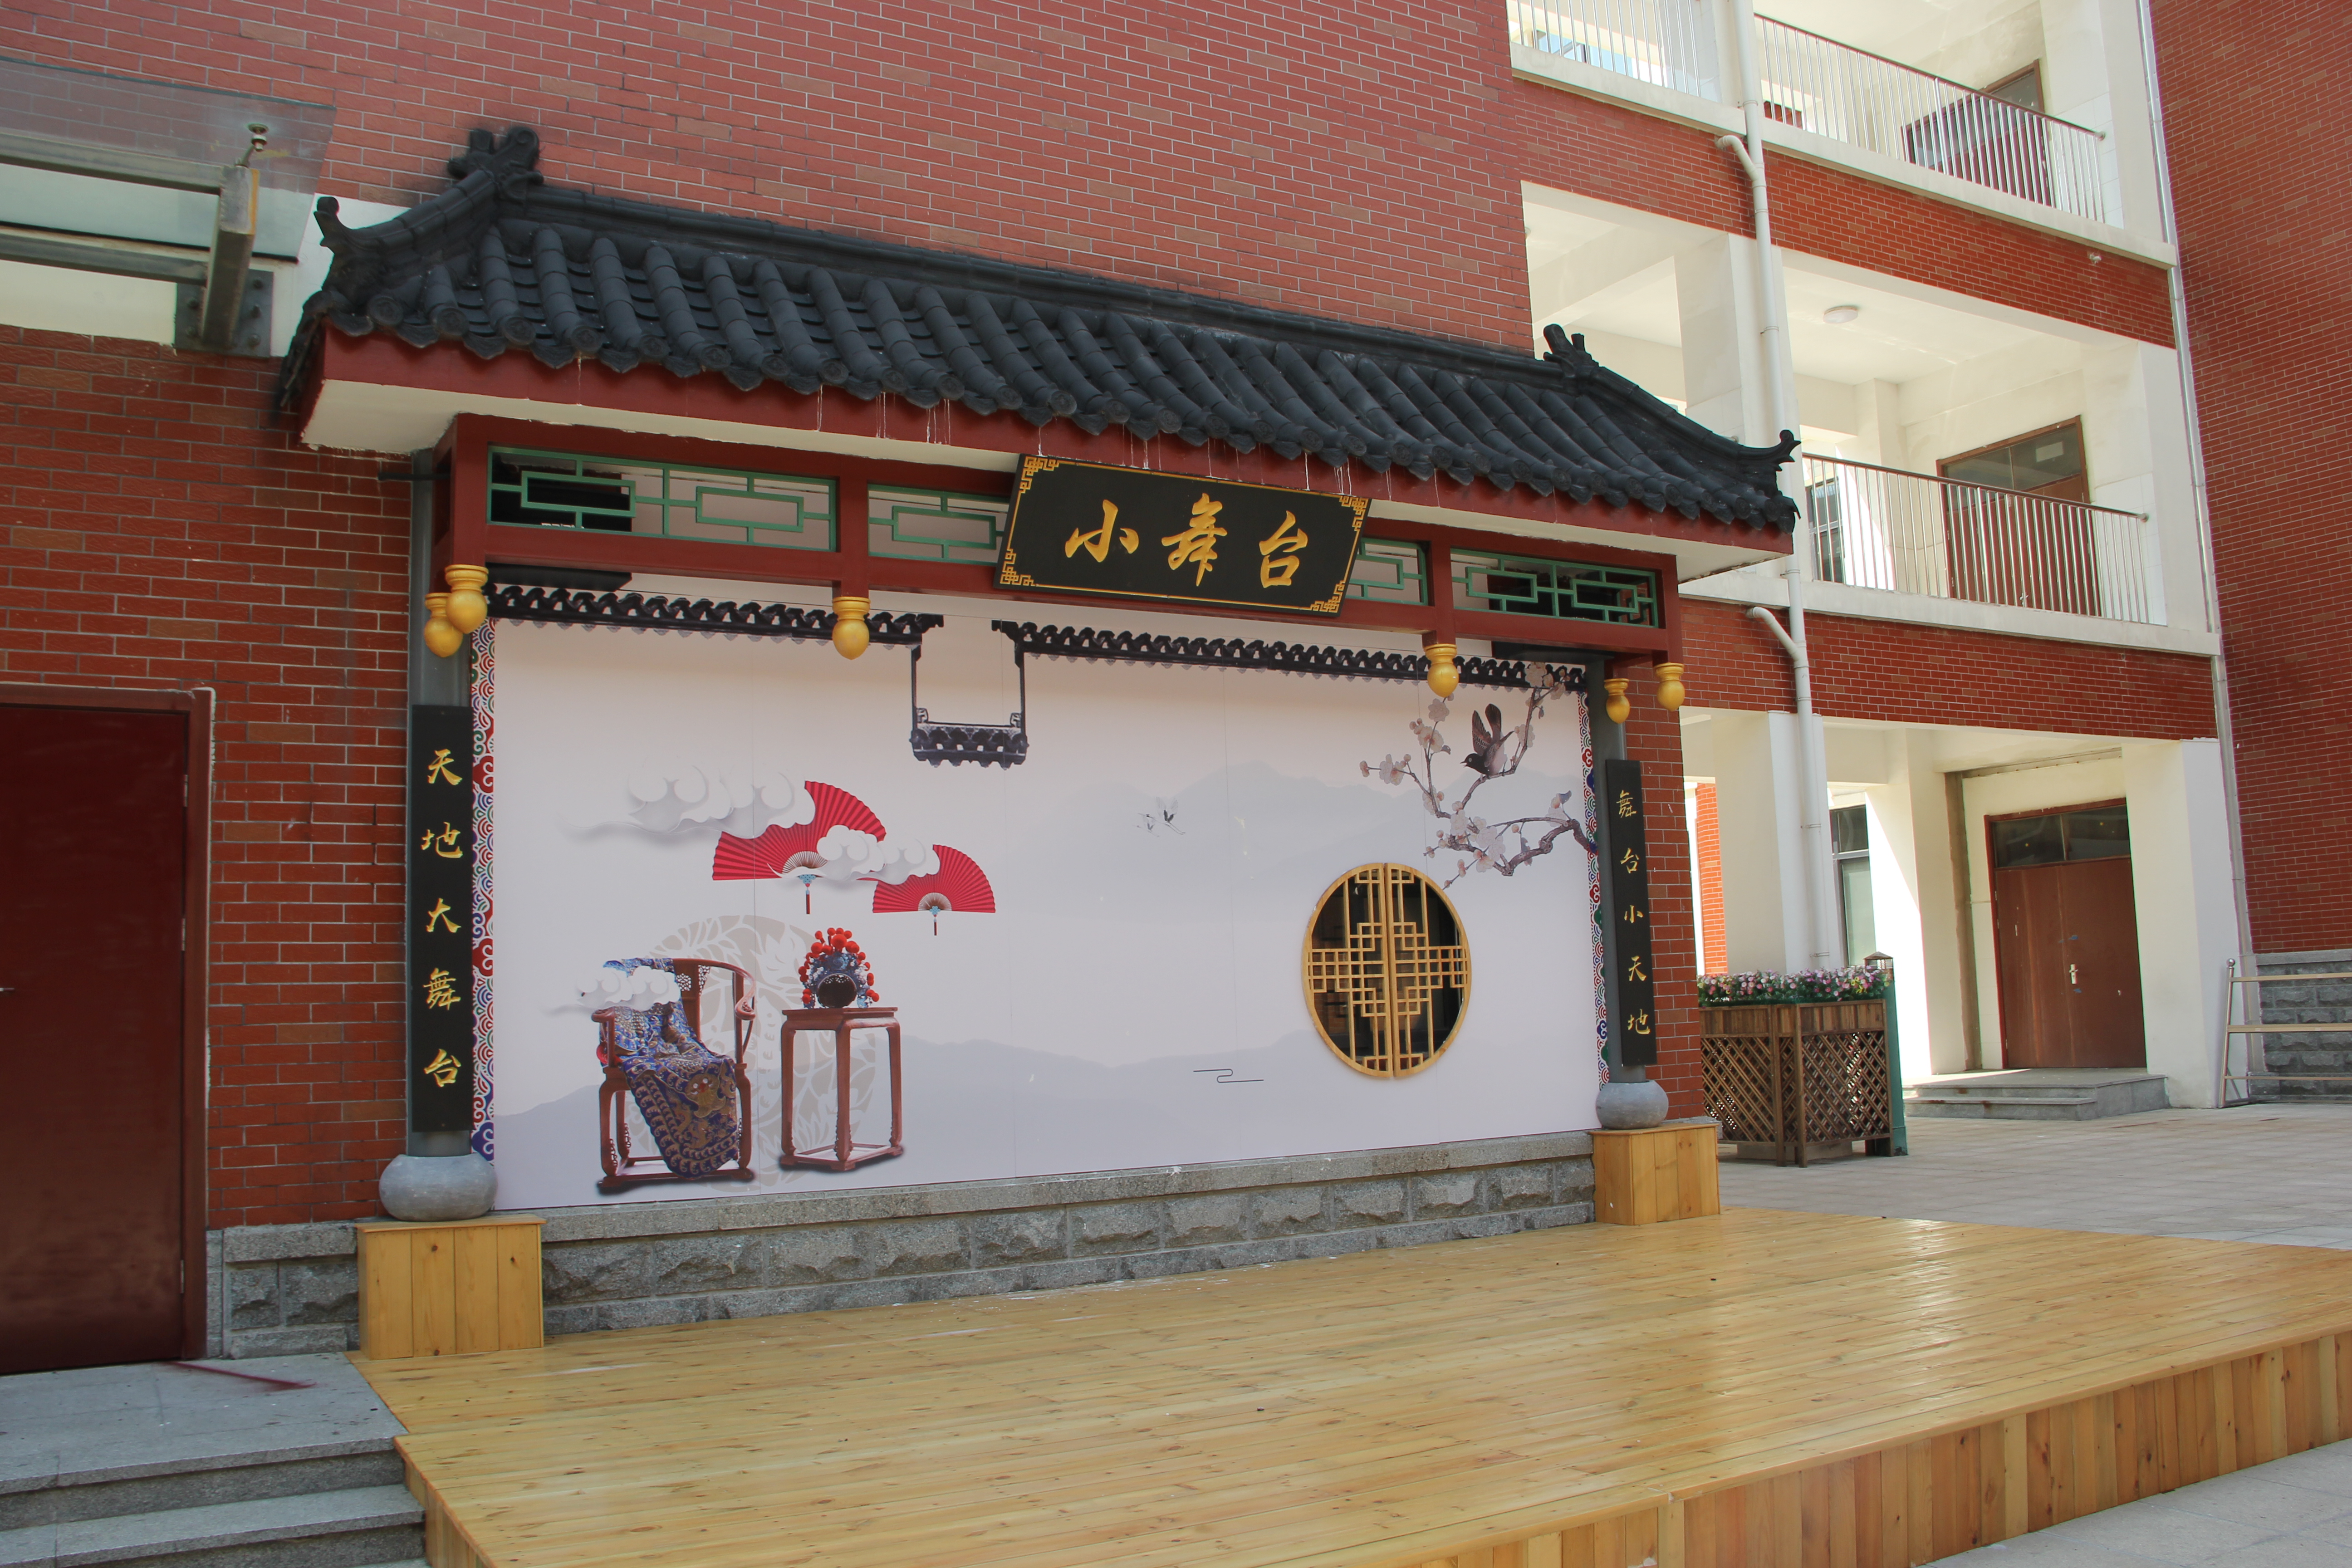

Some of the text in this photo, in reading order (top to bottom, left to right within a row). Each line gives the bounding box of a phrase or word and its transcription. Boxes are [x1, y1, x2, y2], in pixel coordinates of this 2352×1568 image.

[1064, 492, 1308, 588] 小舞台
[421, 748, 463, 1088] 天地大舞台
[1616, 789, 1651, 1035] 舞台小天地
